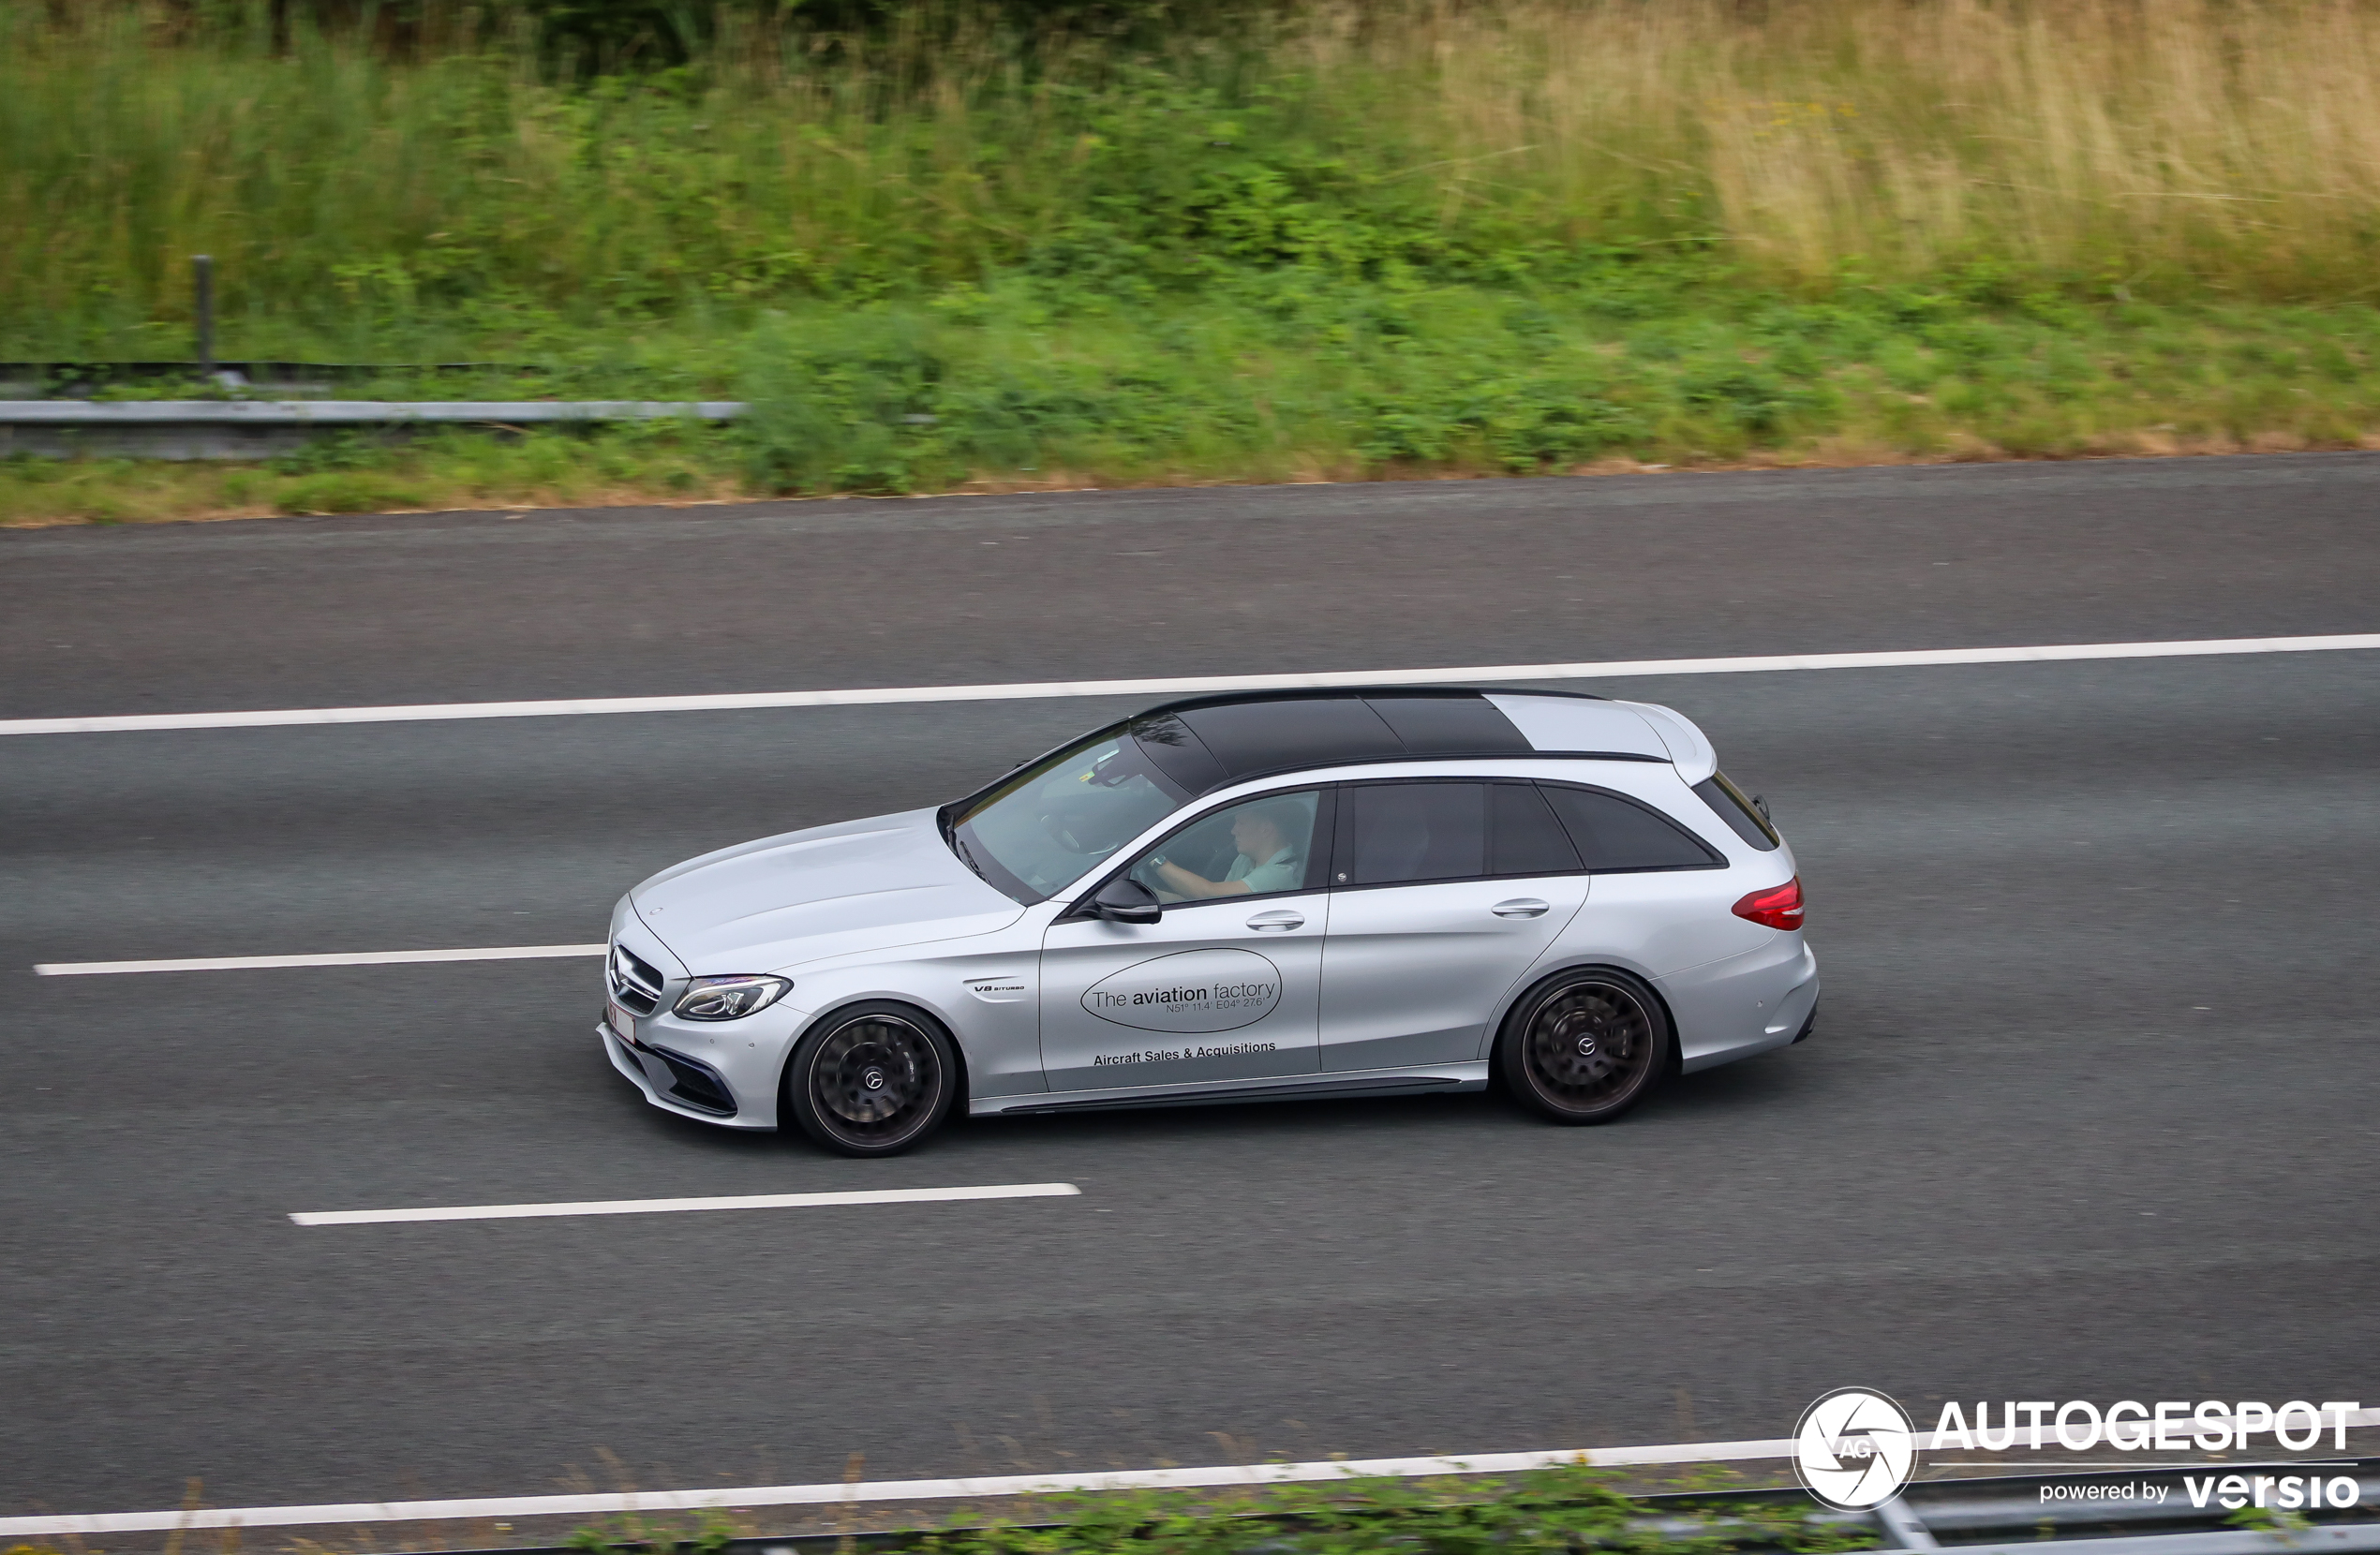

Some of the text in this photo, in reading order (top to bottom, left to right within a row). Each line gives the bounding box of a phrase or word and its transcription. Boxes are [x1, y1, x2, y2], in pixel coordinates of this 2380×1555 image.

[1093, 982, 1275, 1008] The aviation factory
[1093, 1042, 1276, 1066] Aircraft Sales & Acquisitions
